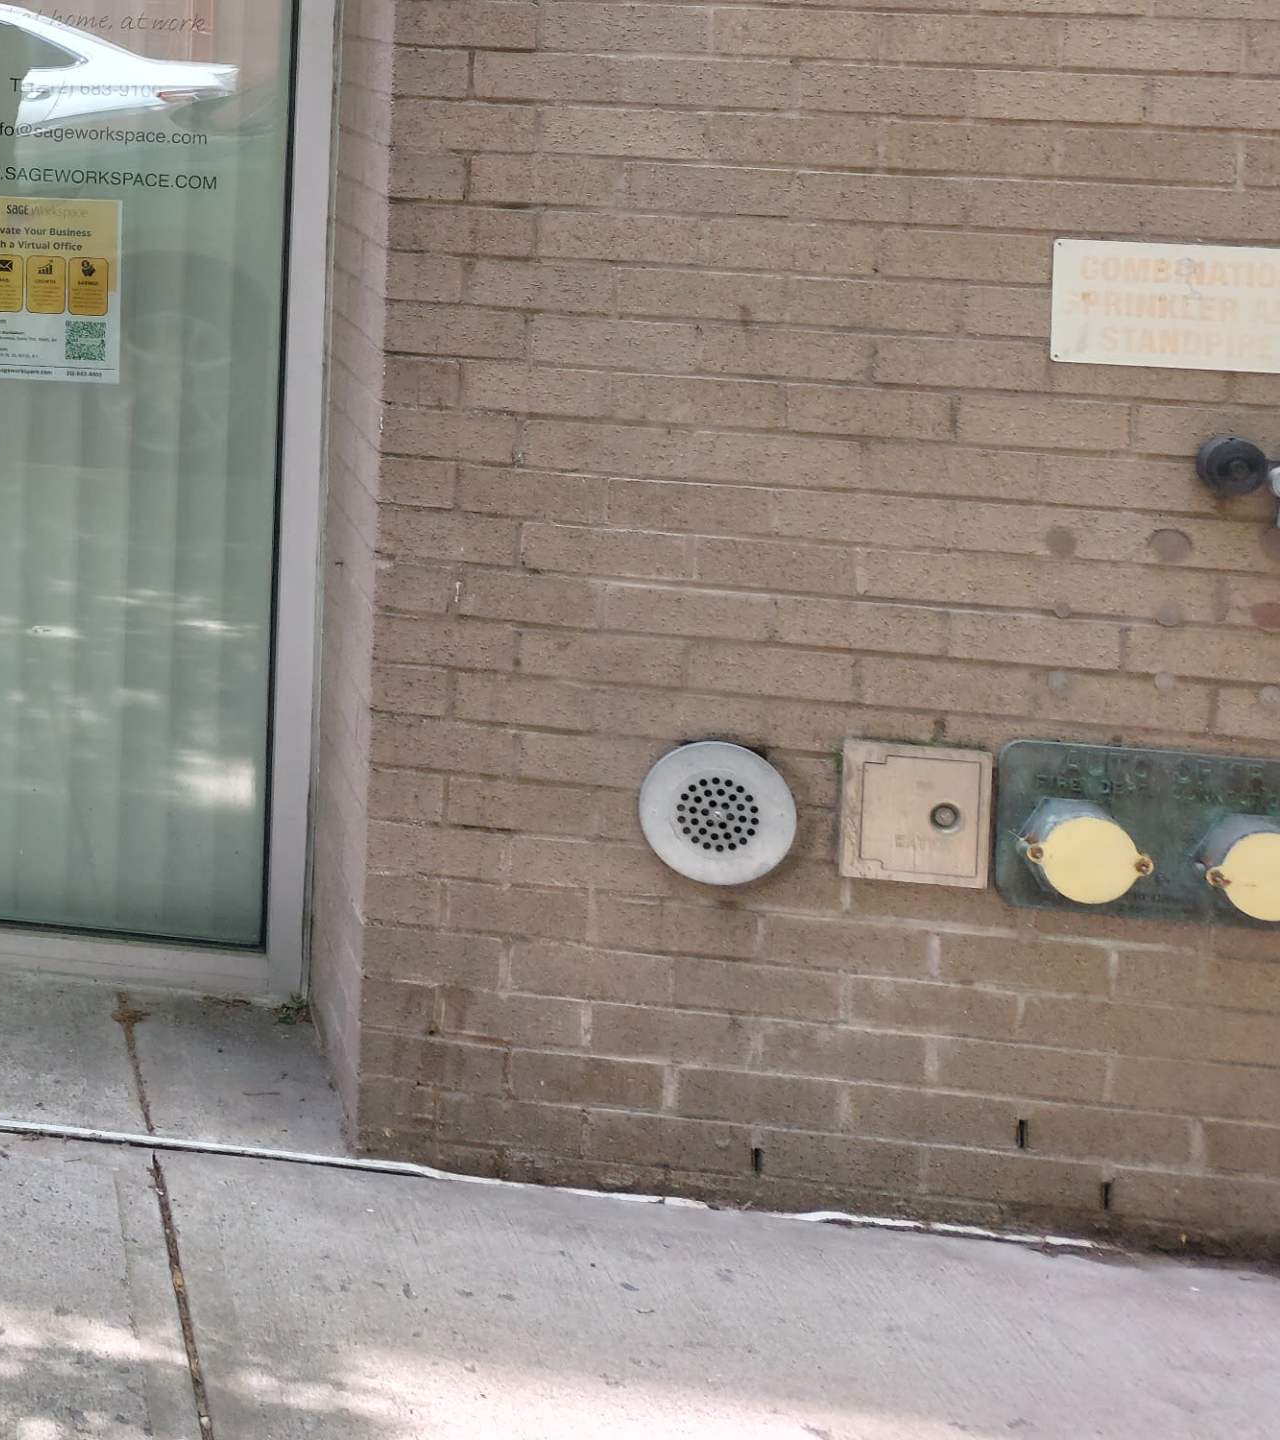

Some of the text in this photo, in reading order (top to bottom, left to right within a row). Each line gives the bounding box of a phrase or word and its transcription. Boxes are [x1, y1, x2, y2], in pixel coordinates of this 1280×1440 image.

[120, 13, 148, 30] at
[23, 227, 46, 236] Your
[49, 227, 92, 238] Business
[17, 241, 50, 251] Virtual
[53, 242, 83, 252] Office
